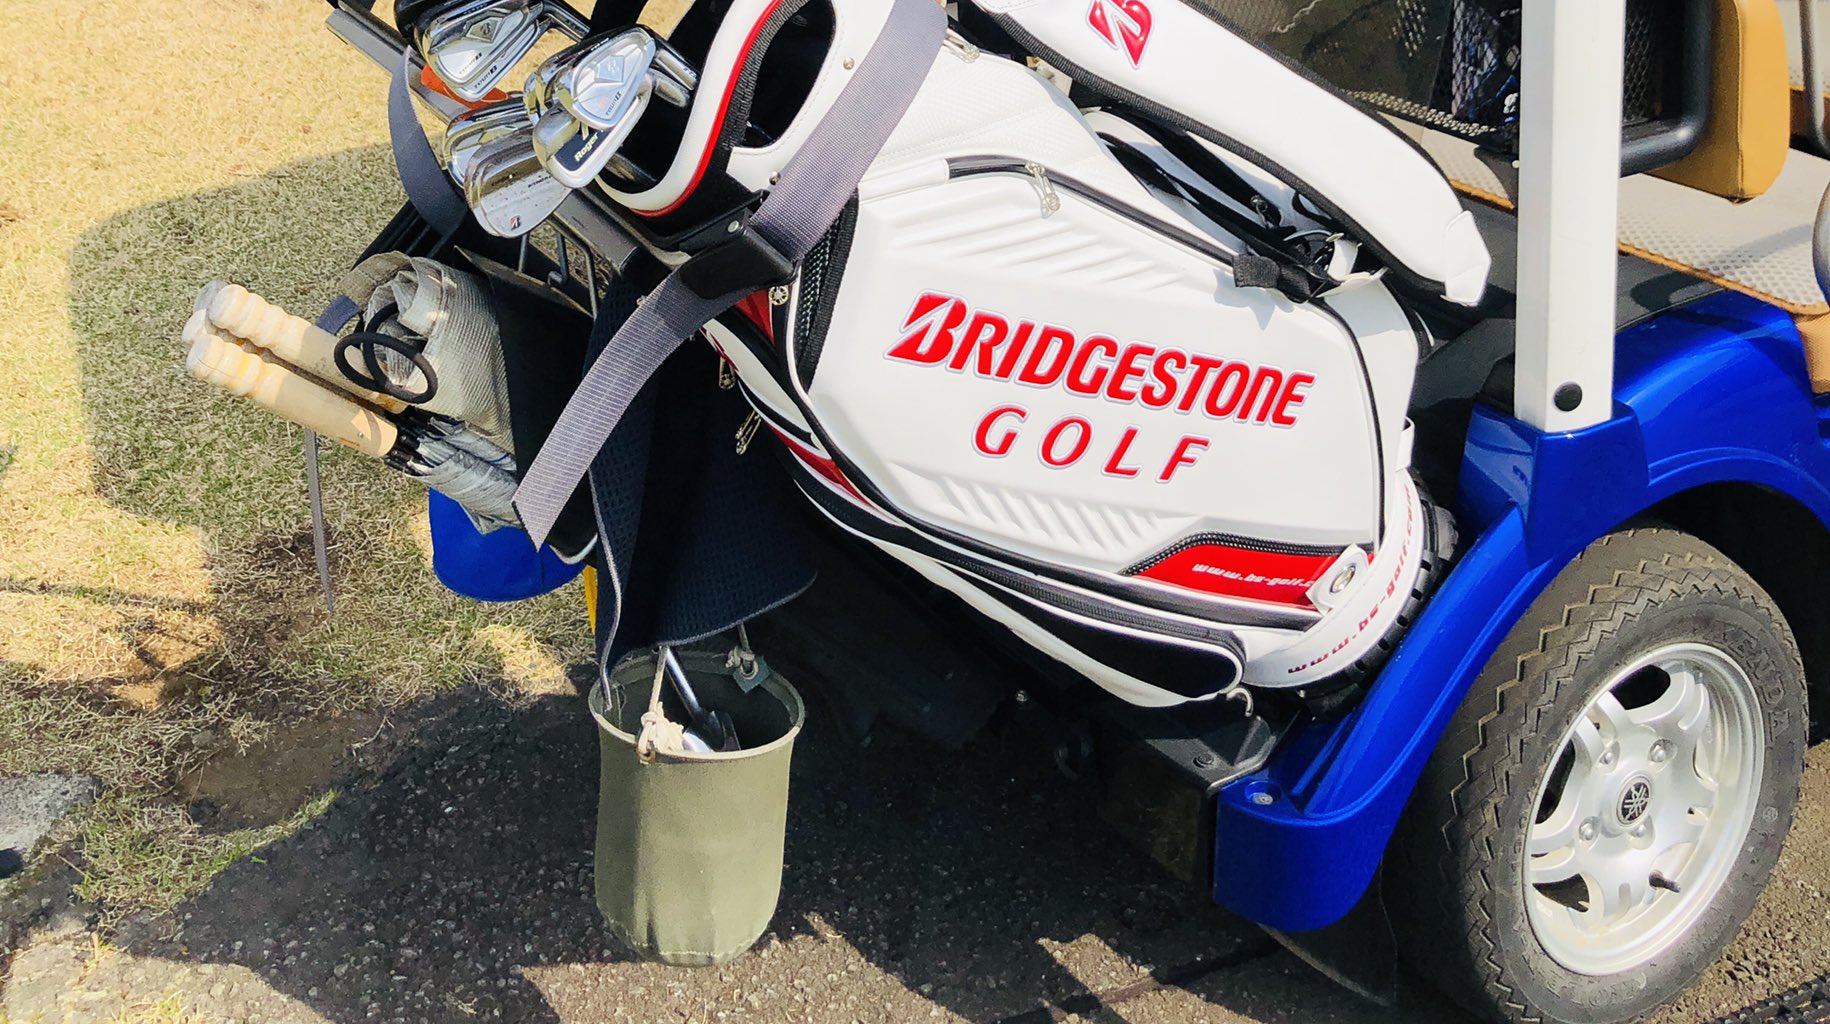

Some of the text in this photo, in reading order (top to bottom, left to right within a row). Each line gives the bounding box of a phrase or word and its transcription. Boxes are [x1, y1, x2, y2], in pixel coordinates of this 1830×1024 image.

[574, 132, 599, 162] Roger
[884, 289, 1318, 428] BRIDGESTONE
[971, 402, 1211, 484] GOLF
[1192, 563, 1314, 588] www.bs-golf.c
[1704, 617, 1791, 743] KENDA
